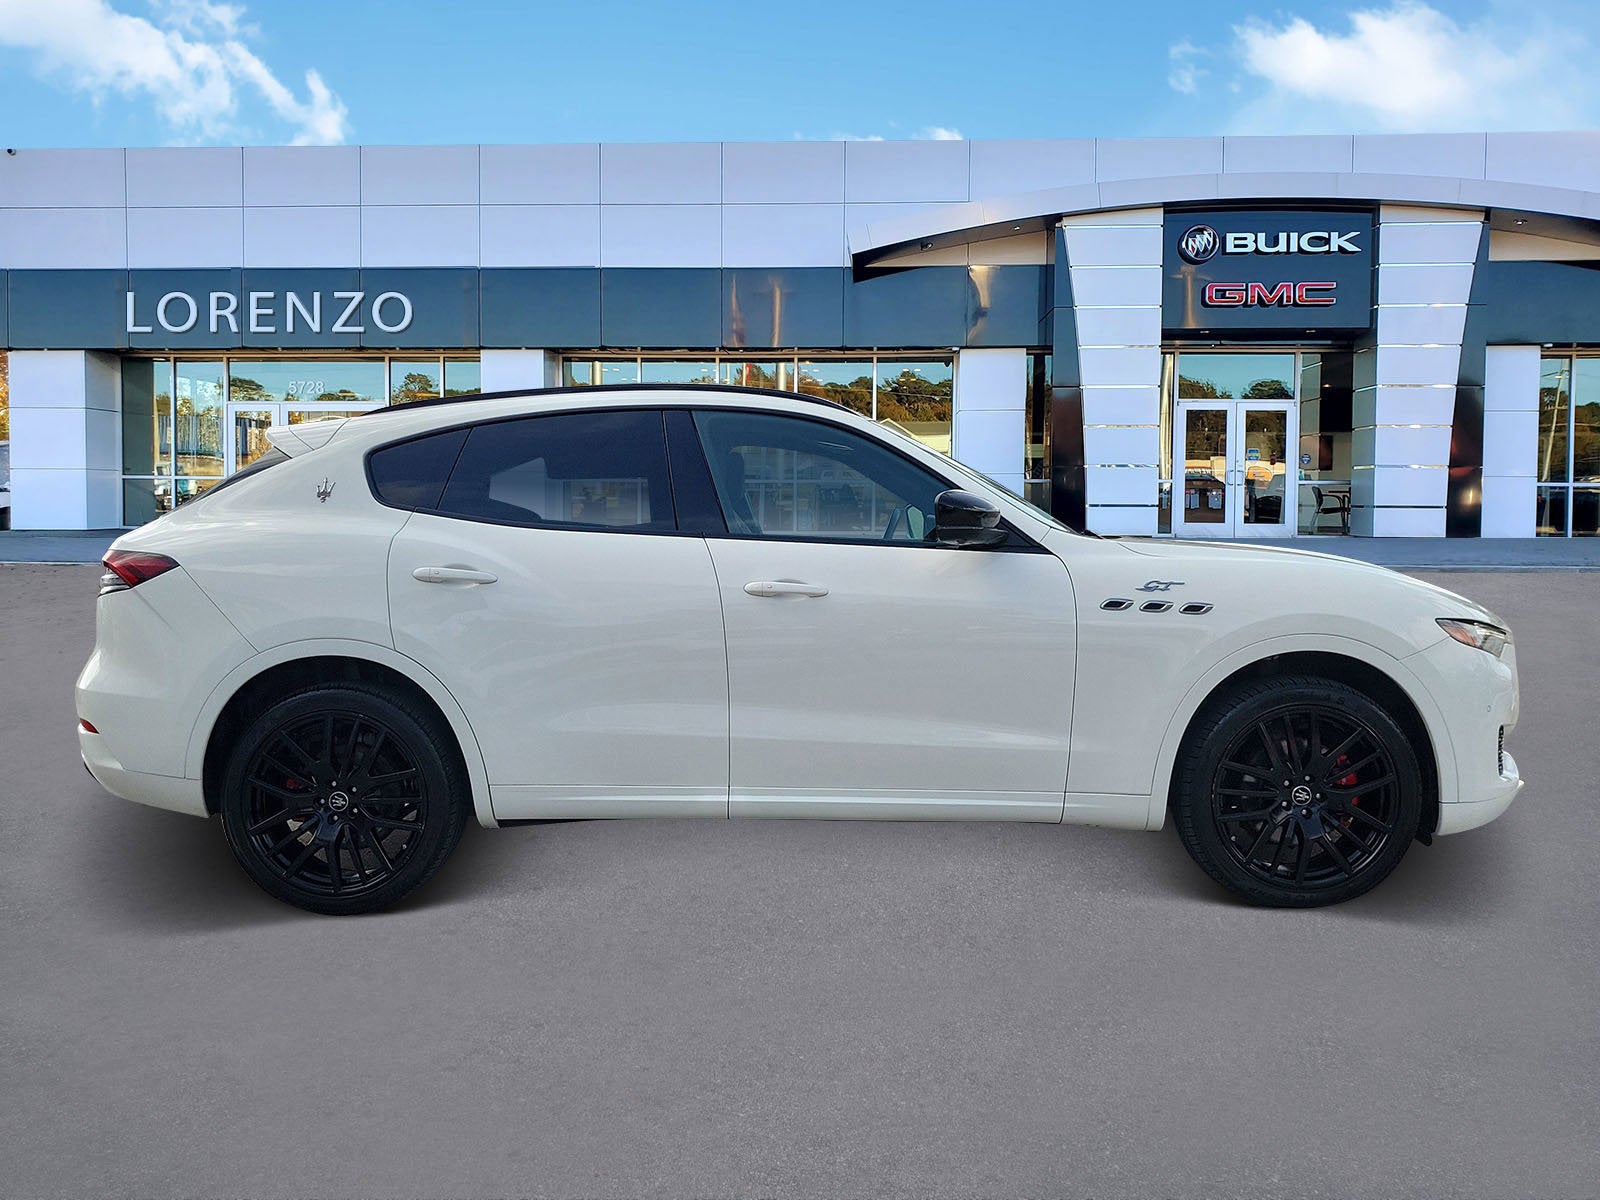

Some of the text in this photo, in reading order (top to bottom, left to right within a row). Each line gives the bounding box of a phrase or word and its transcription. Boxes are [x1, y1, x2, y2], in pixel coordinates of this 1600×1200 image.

[1226, 231, 1362, 253] BUICK
[1205, 281, 1337, 305] GMC
[126, 291, 414, 333] LORENZO
[288, 380, 325, 394] 5728
[1135, 580, 1185, 592] GT
